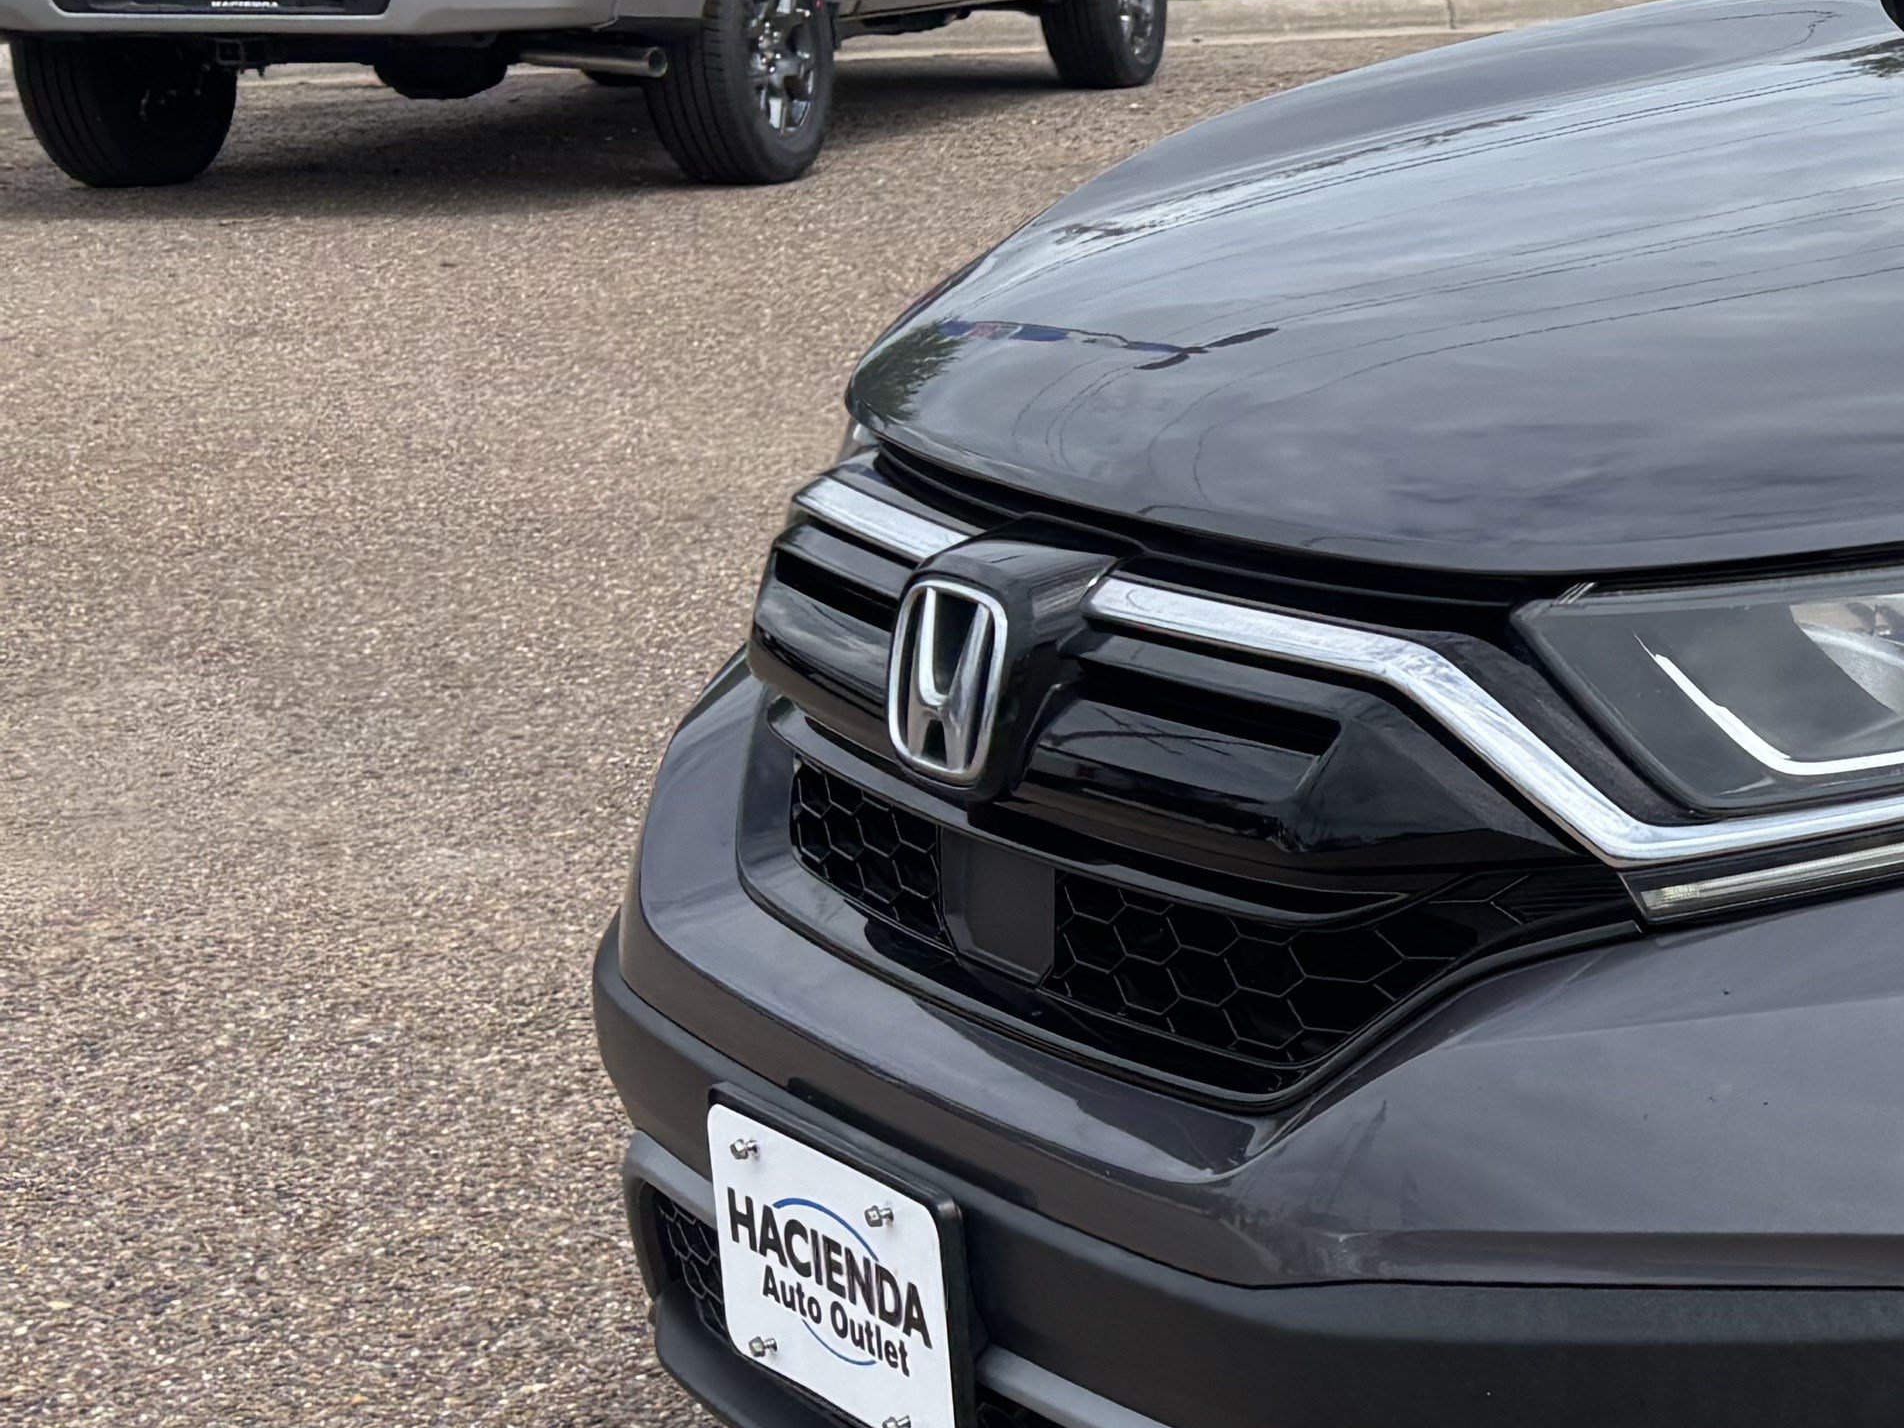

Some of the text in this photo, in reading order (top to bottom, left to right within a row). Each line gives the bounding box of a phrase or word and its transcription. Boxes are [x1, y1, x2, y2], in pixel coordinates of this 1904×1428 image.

[726, 1186, 933, 1349] HACIENDA
[761, 1264, 911, 1377] Auto Outlet
